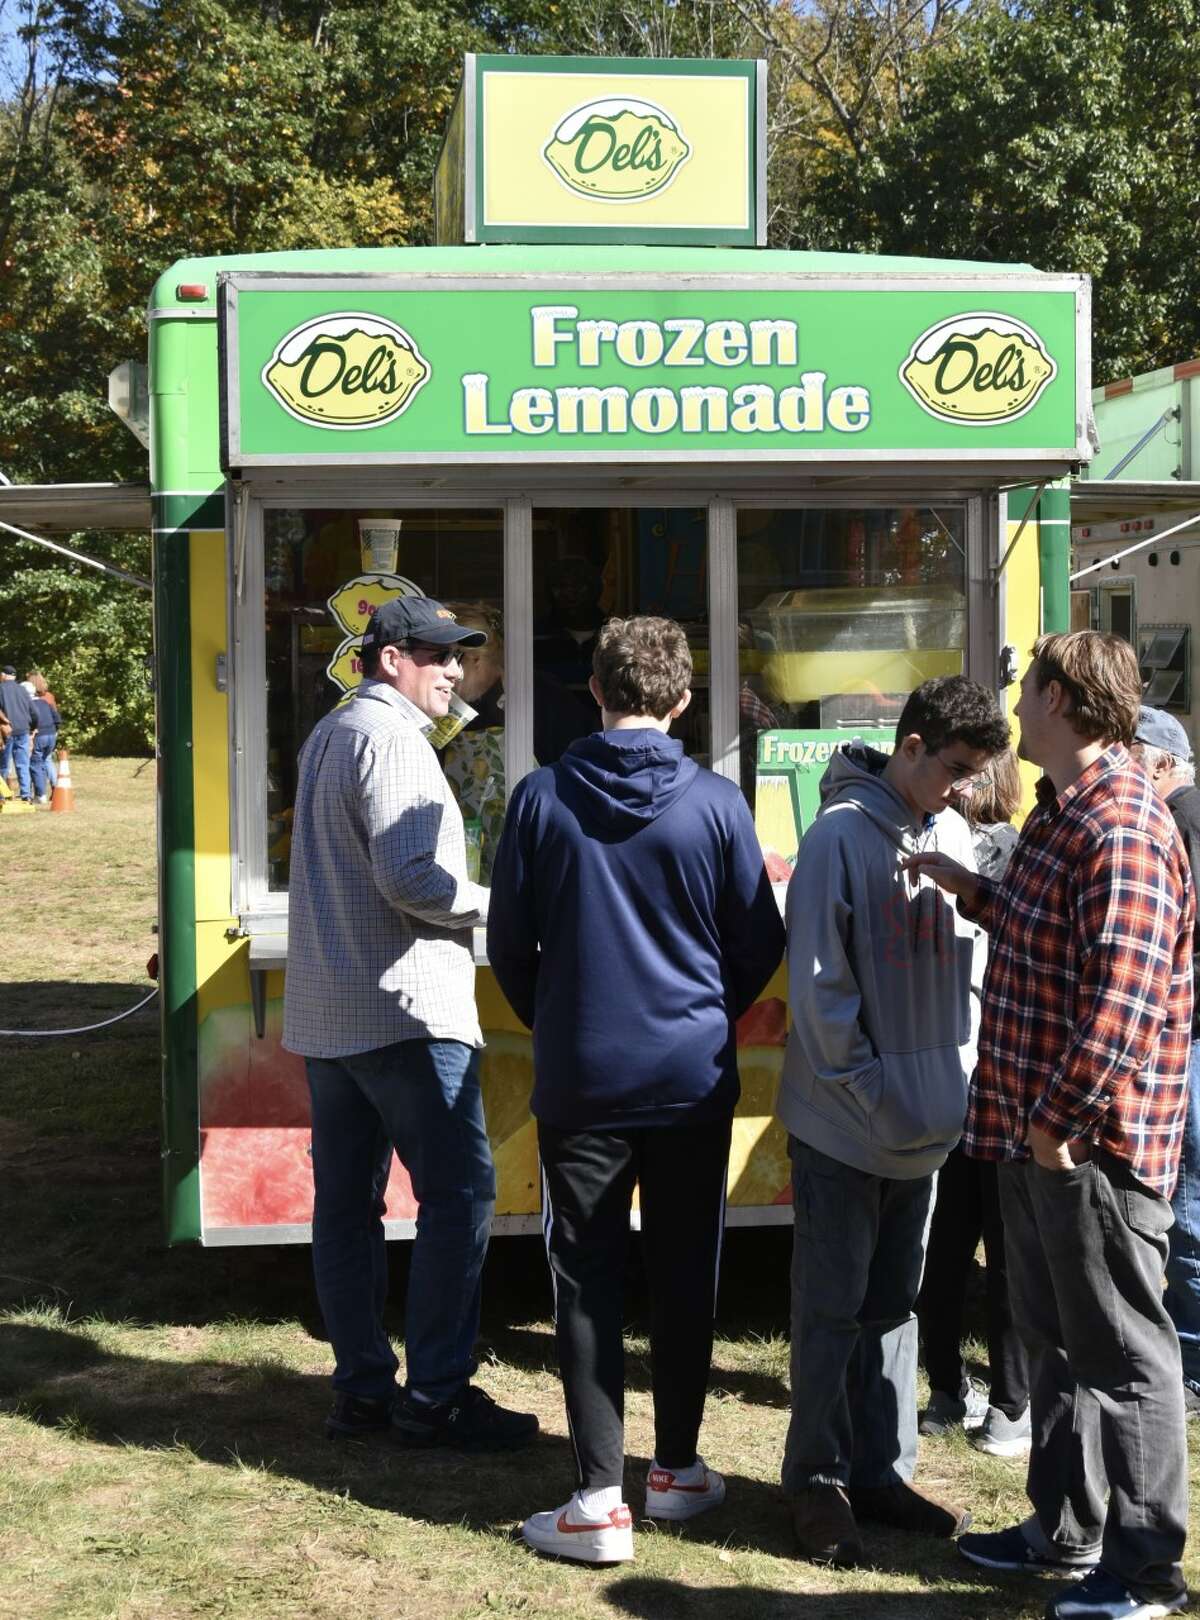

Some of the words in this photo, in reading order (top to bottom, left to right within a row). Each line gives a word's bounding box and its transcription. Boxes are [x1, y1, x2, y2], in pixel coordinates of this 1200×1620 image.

[574, 122, 668, 174] Del's
[530, 304, 799, 368] Frozen
[299, 342, 403, 398] Del's
[934, 341, 1031, 395] Del's
[461, 370, 871, 435] Lemonade
